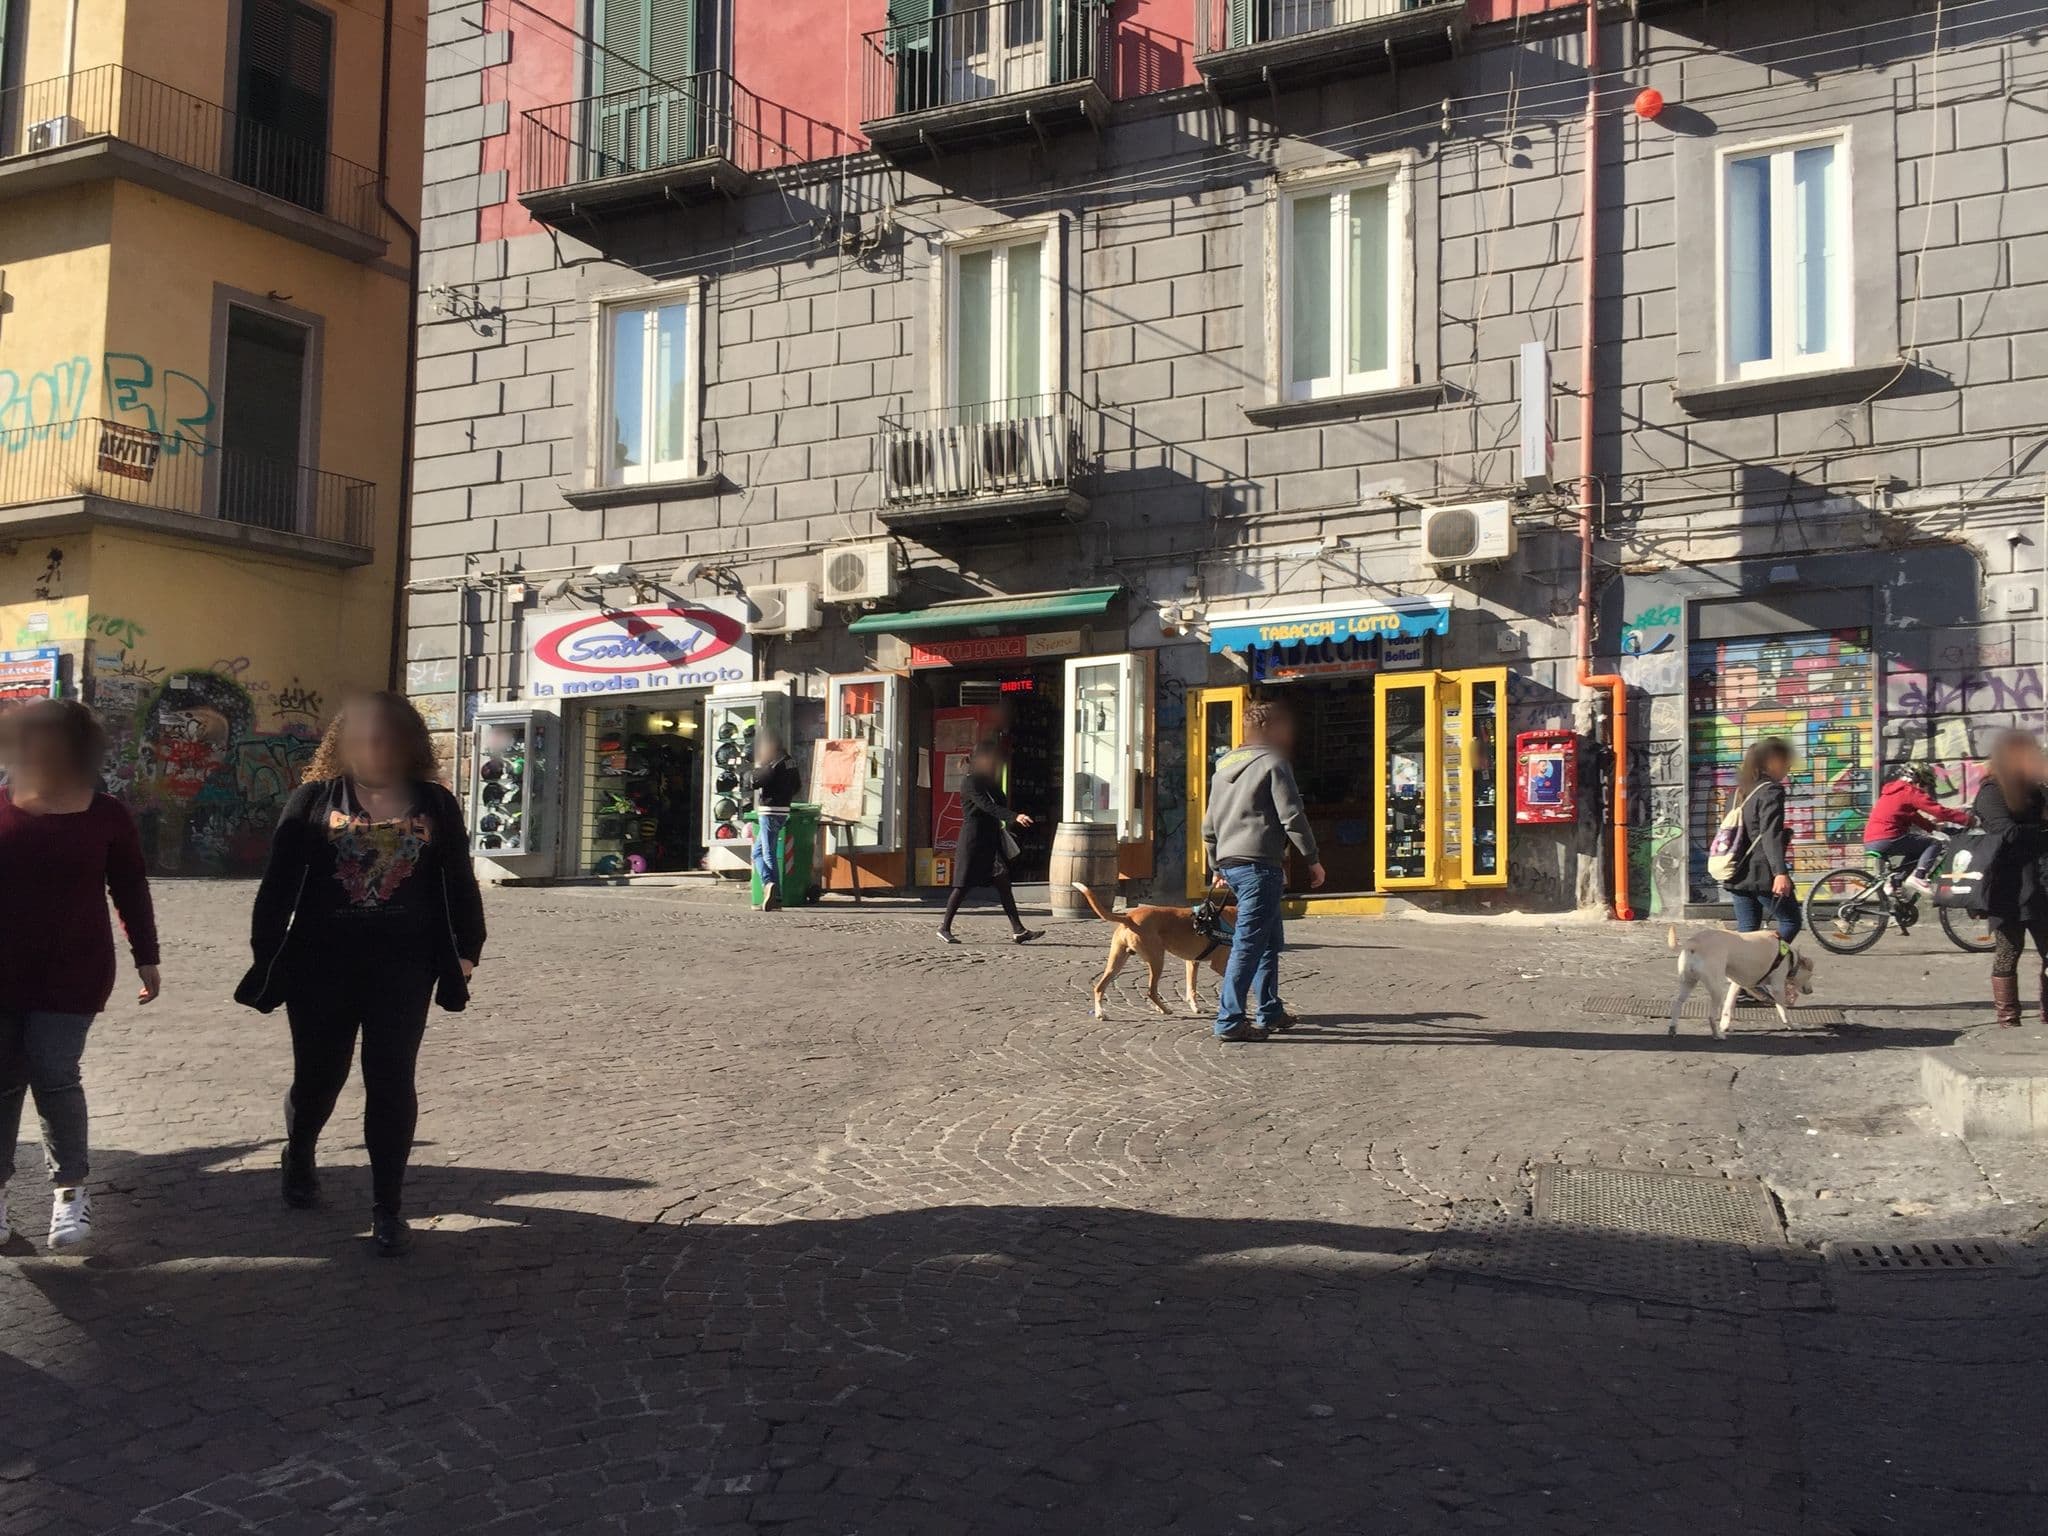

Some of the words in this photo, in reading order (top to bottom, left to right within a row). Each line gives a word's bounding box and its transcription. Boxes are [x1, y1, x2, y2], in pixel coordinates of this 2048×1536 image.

[1259, 620, 1335, 641] TABACCHI
[1348, 614, 1400, 633] LOTTO
[569, 630, 703, 662] Scotland
[1384, 649, 1420, 662] Bollati
[534, 682, 554, 697] la
[563, 675, 640, 694] moda
[647, 672, 669, 688] in
[678, 667, 744, 685] moto
[1001, 680, 1033, 692] BIBITE
